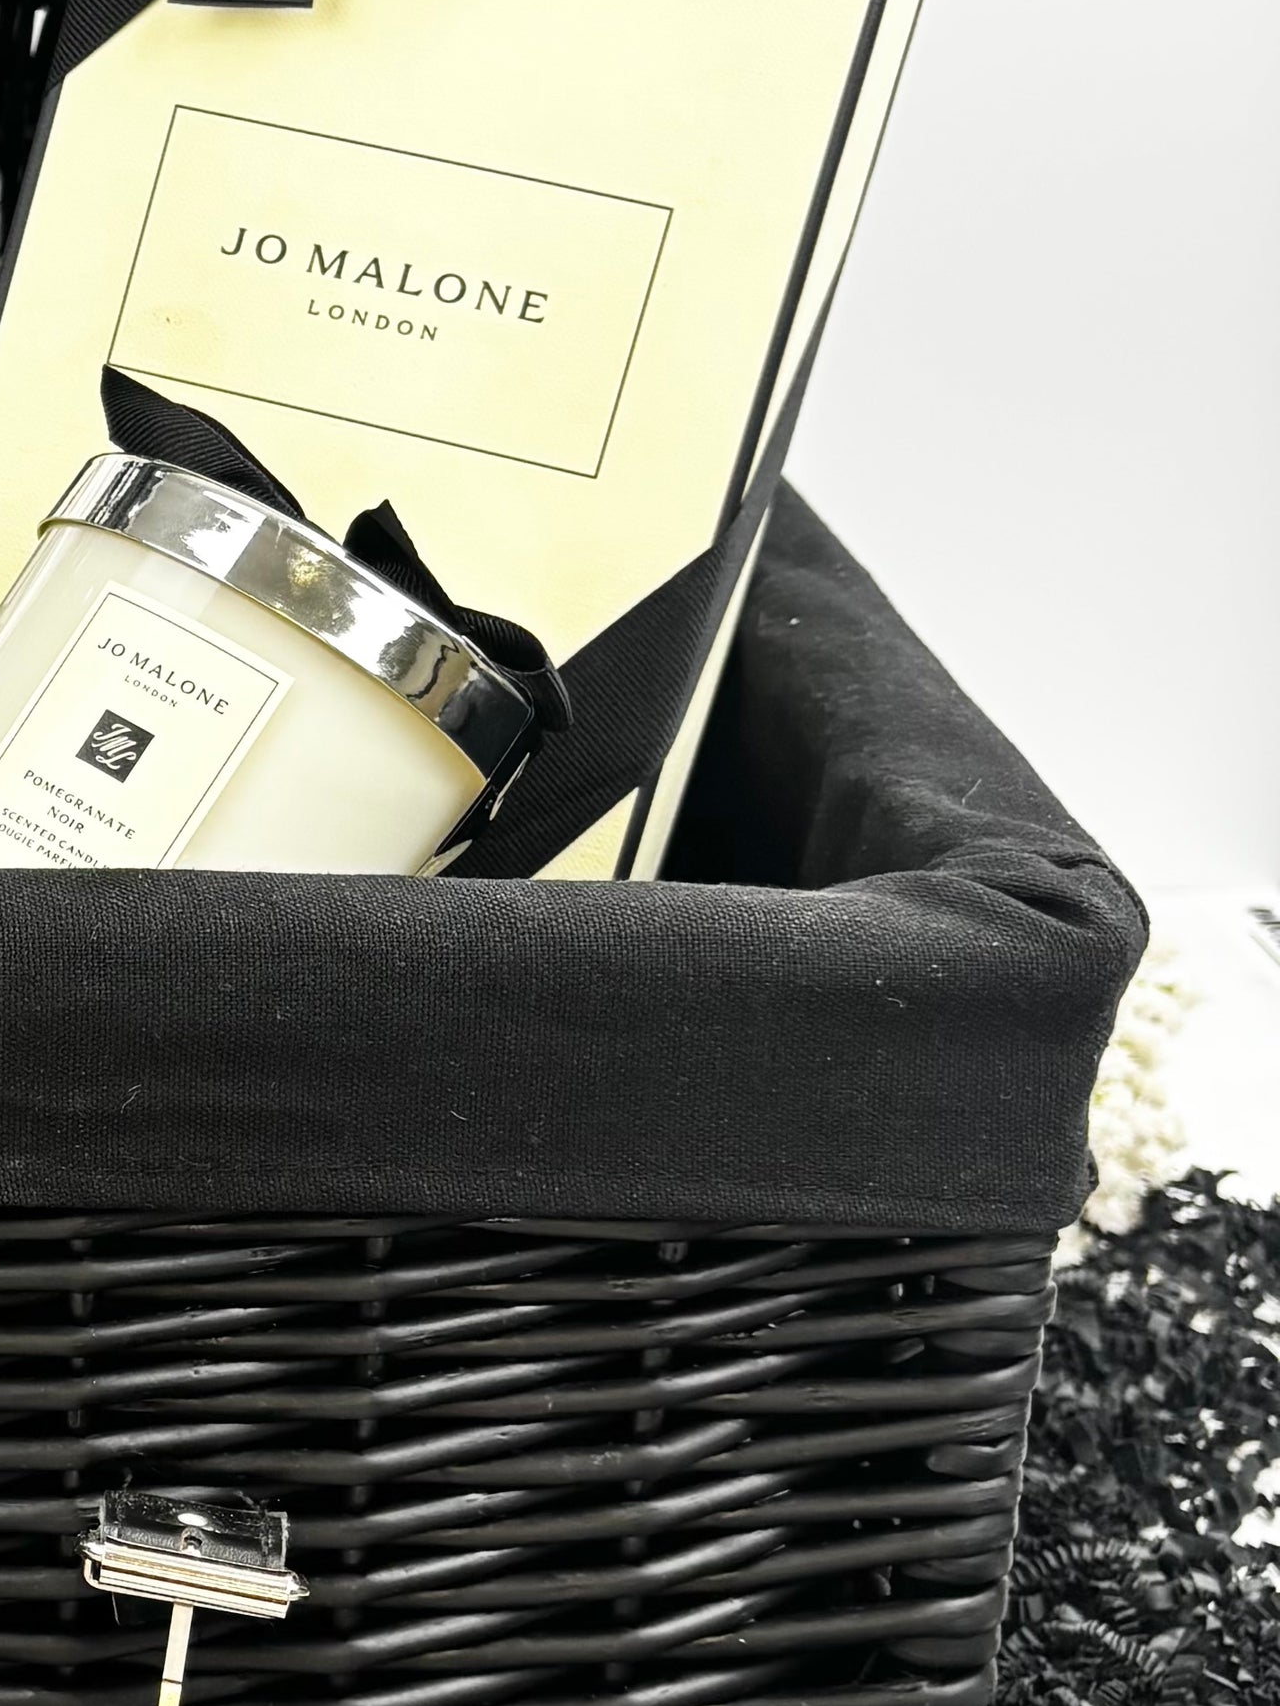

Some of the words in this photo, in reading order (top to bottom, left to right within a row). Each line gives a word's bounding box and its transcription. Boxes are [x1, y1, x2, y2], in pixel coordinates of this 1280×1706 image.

[220, 227, 288, 266] JO
[306, 243, 550, 325] MALONE
[307, 299, 440, 342] LONDON
[98, 638, 126, 657] JO
[130, 652, 229, 715] MALONE
[124, 675, 178, 707] LONDON
[2, 808, 57, 843] SCENTED
[23, 769, 136, 840] POMEGRANATE
[47, 805, 85, 834] NOIR
